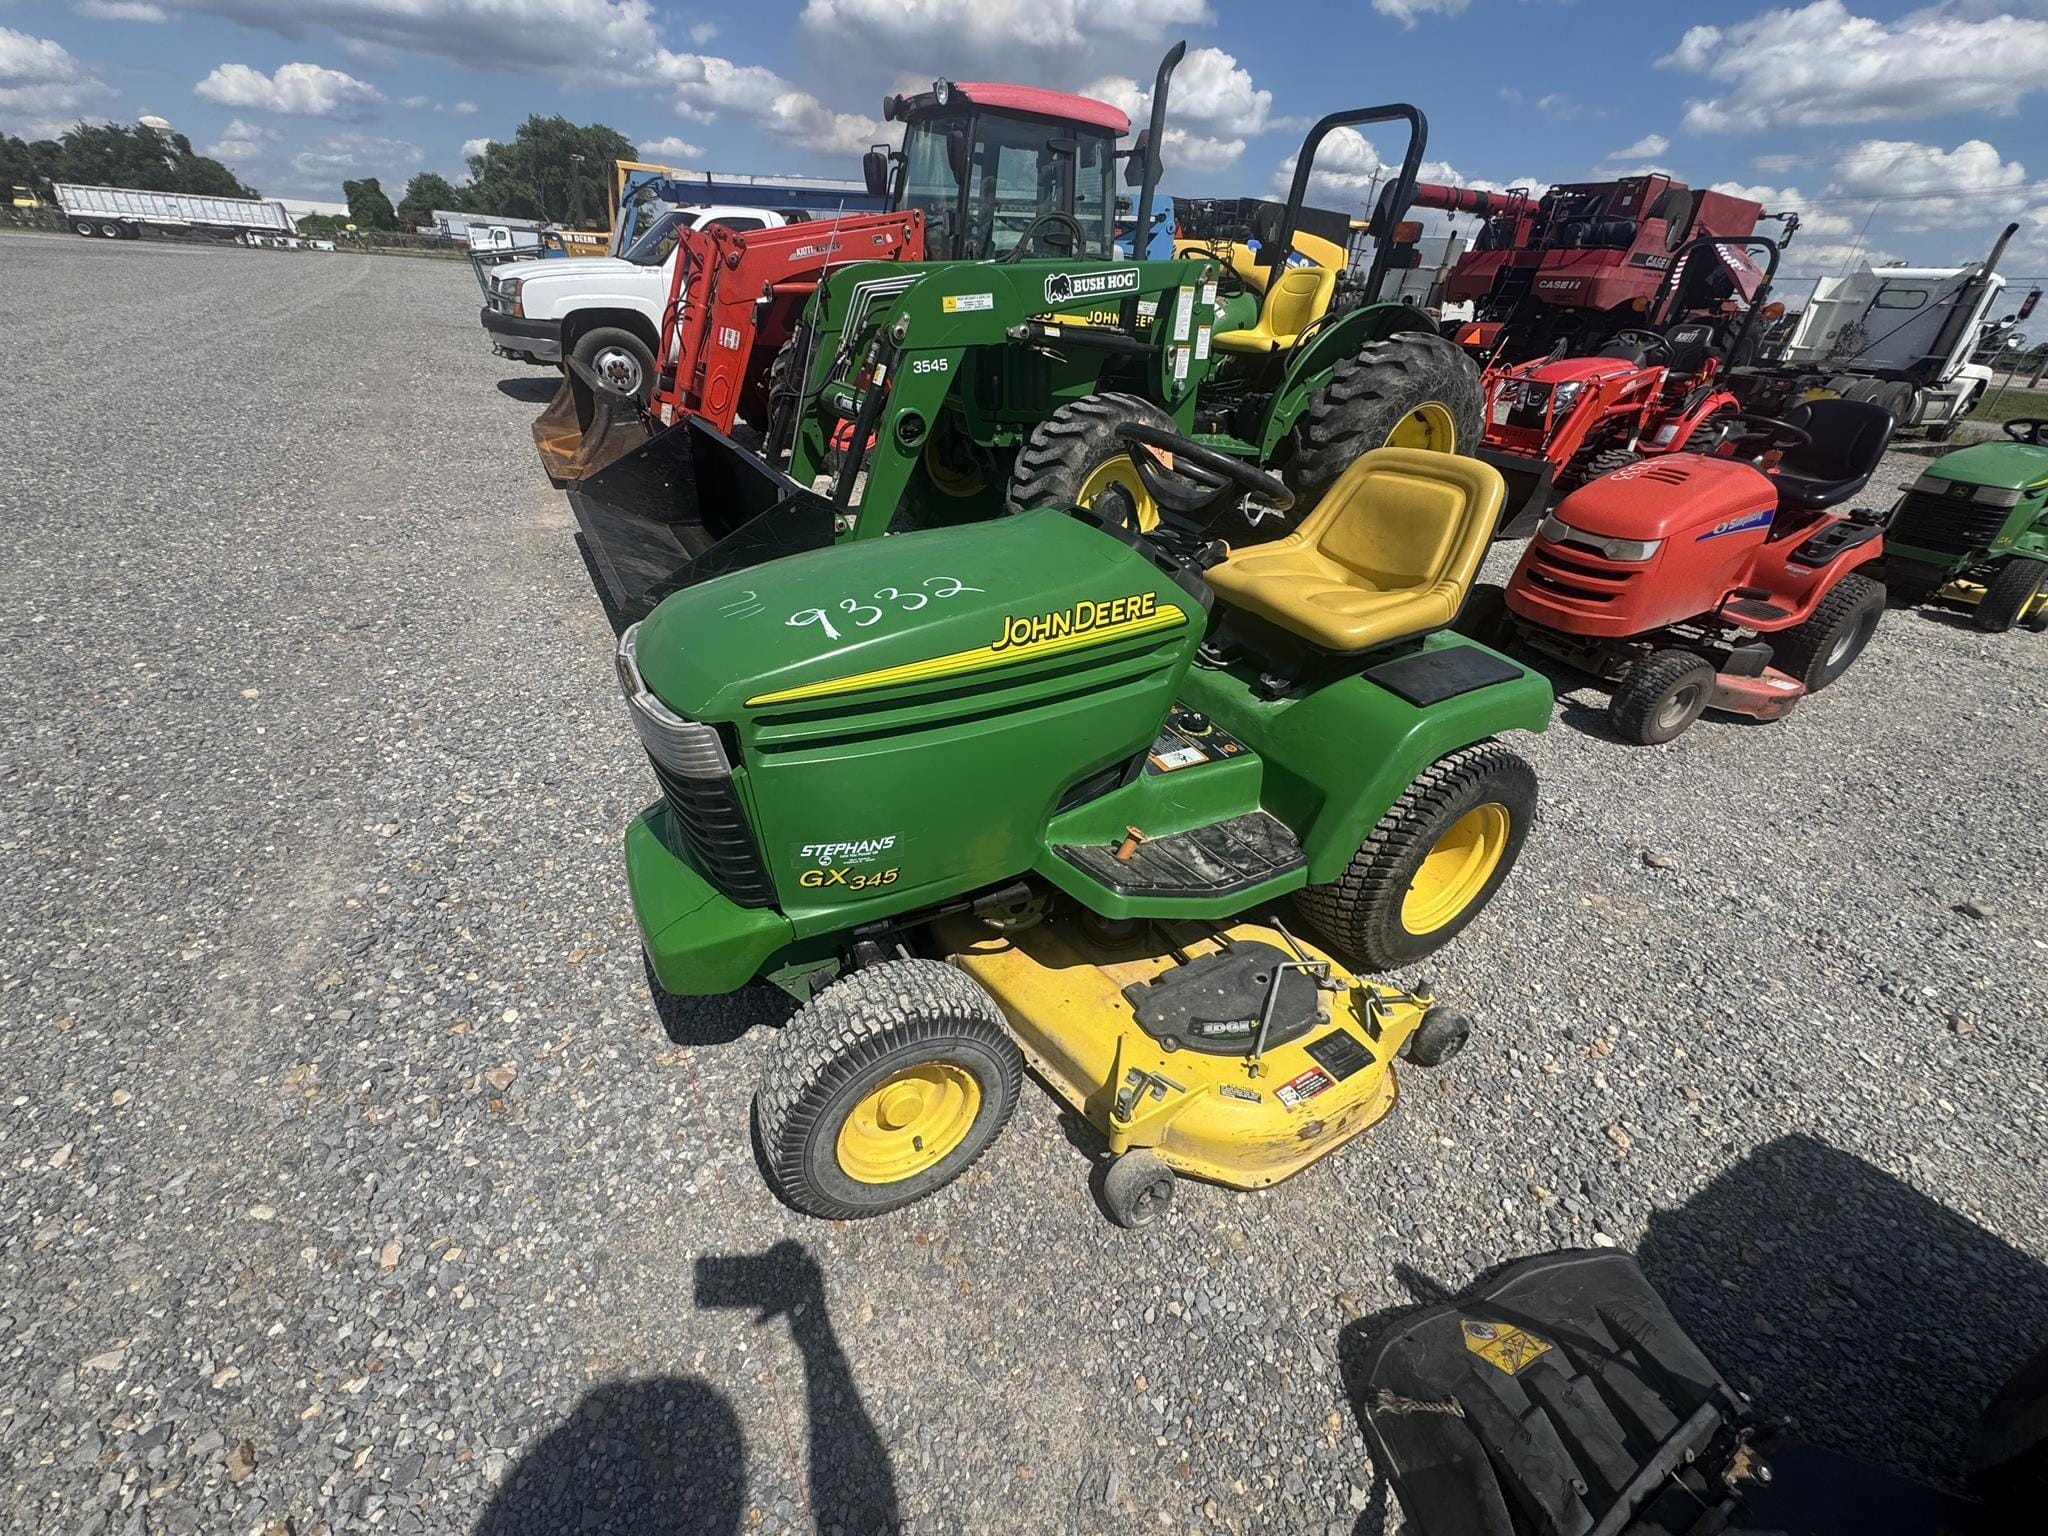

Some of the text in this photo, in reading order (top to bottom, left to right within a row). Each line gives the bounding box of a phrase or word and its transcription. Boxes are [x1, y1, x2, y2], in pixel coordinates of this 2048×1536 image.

[1073, 273, 1134, 293] BUSH HOG
[1538, 279, 1570, 289] CASE
[1086, 310, 1120, 327] JOHN
[913, 358, 948, 374] 3545
[785, 576, 986, 641] 9332
[991, 590, 1158, 651] JOHN DEERE
[799, 866, 901, 892] GX345
[1202, 1020, 1250, 1035] EDGE
